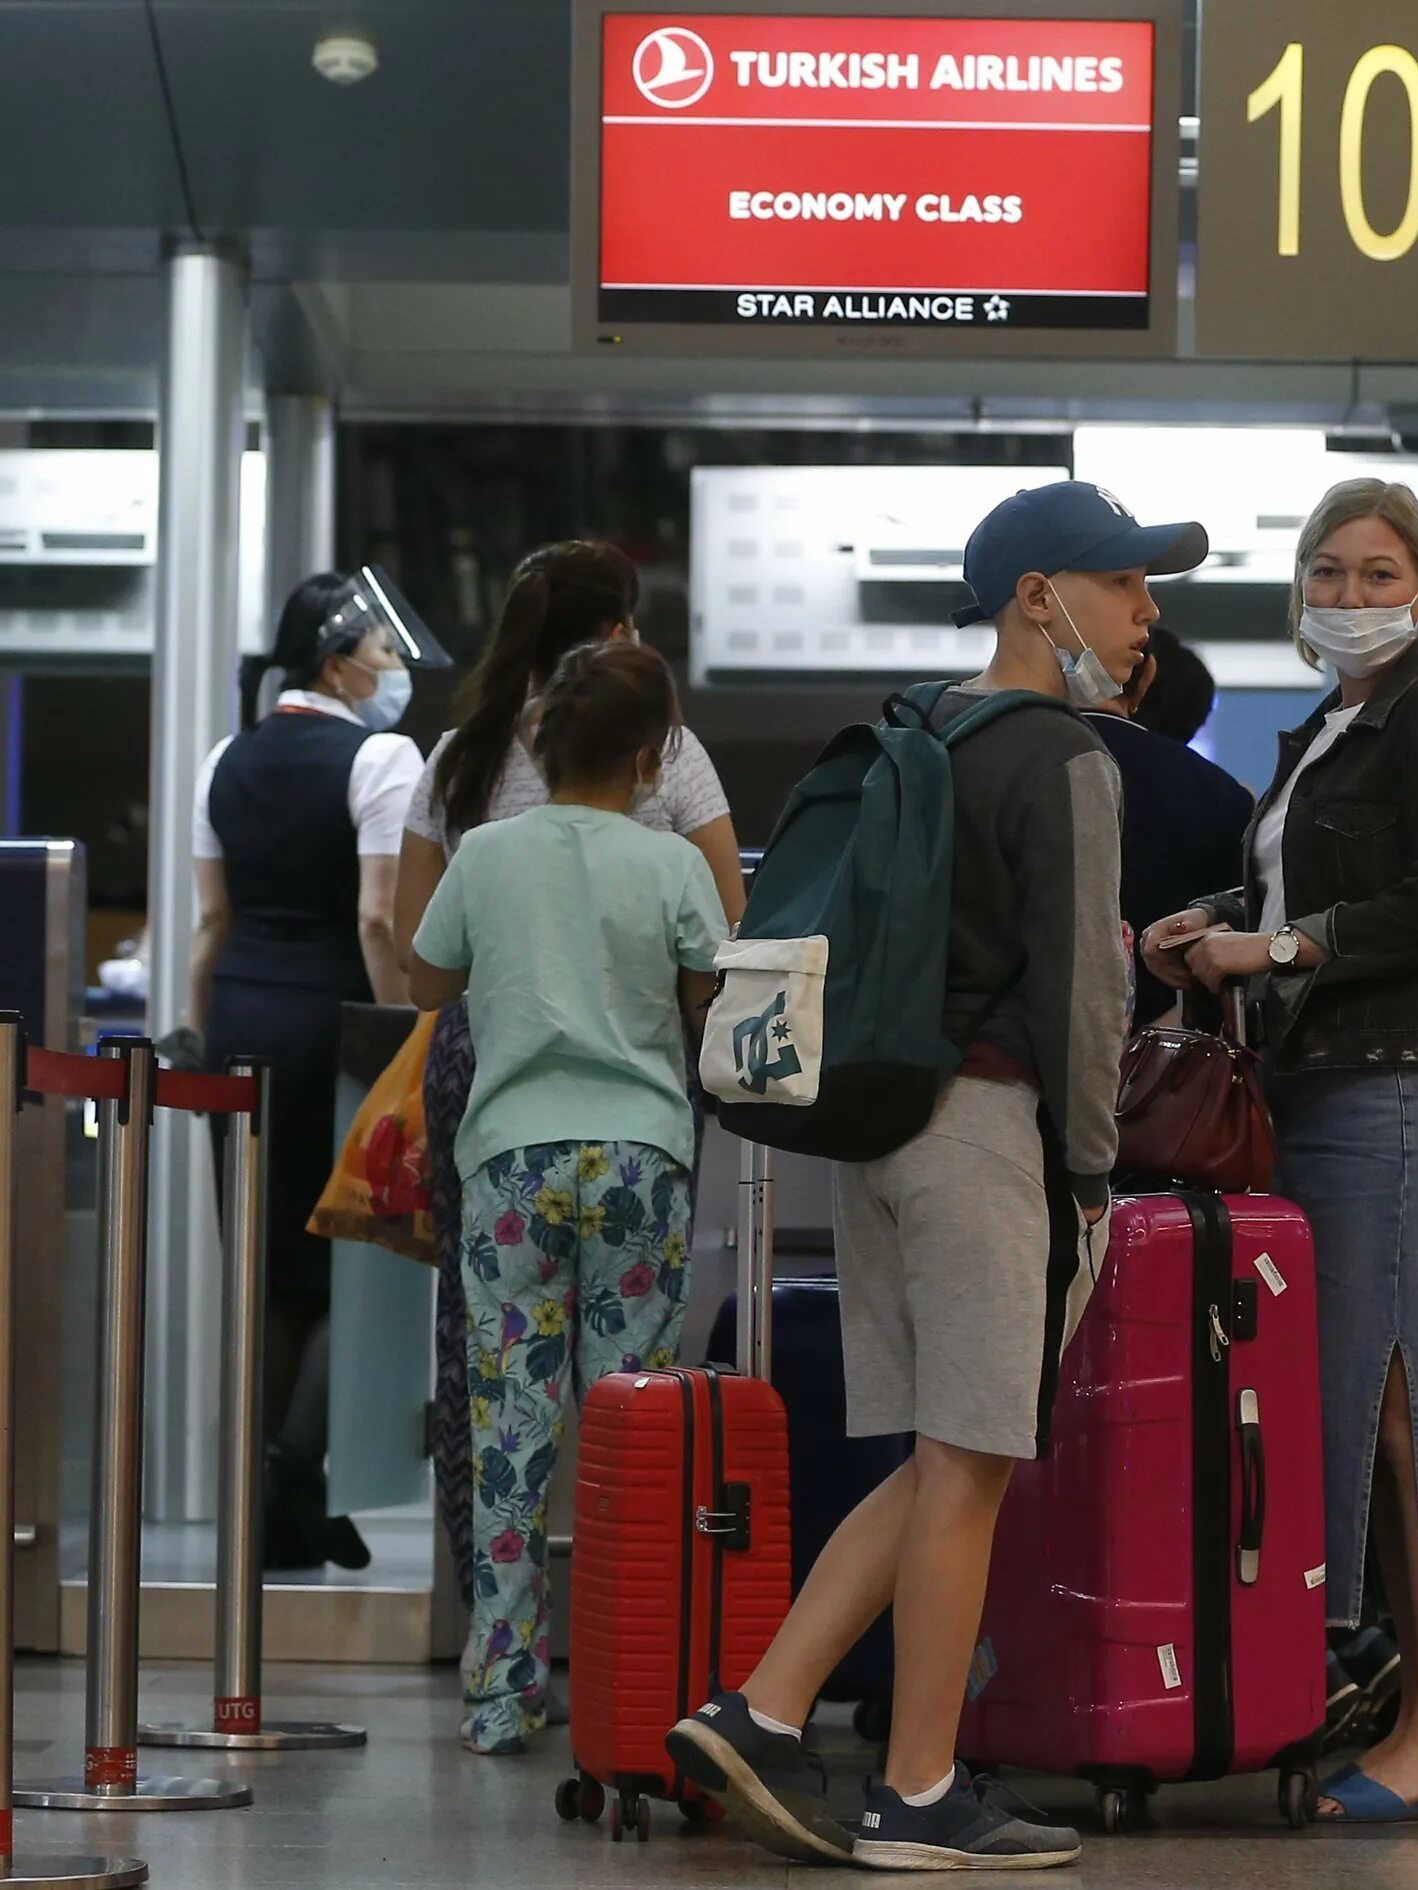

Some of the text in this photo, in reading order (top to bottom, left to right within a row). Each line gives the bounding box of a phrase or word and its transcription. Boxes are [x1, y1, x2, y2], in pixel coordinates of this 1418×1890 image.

[730, 51, 1124, 93] TURKISH AIRLINES
[729, 191, 1022, 223] ECONOMY CLASS
[736, 293, 975, 321] STAR ALLIANCE
[219, 1702, 255, 1719] UTG
